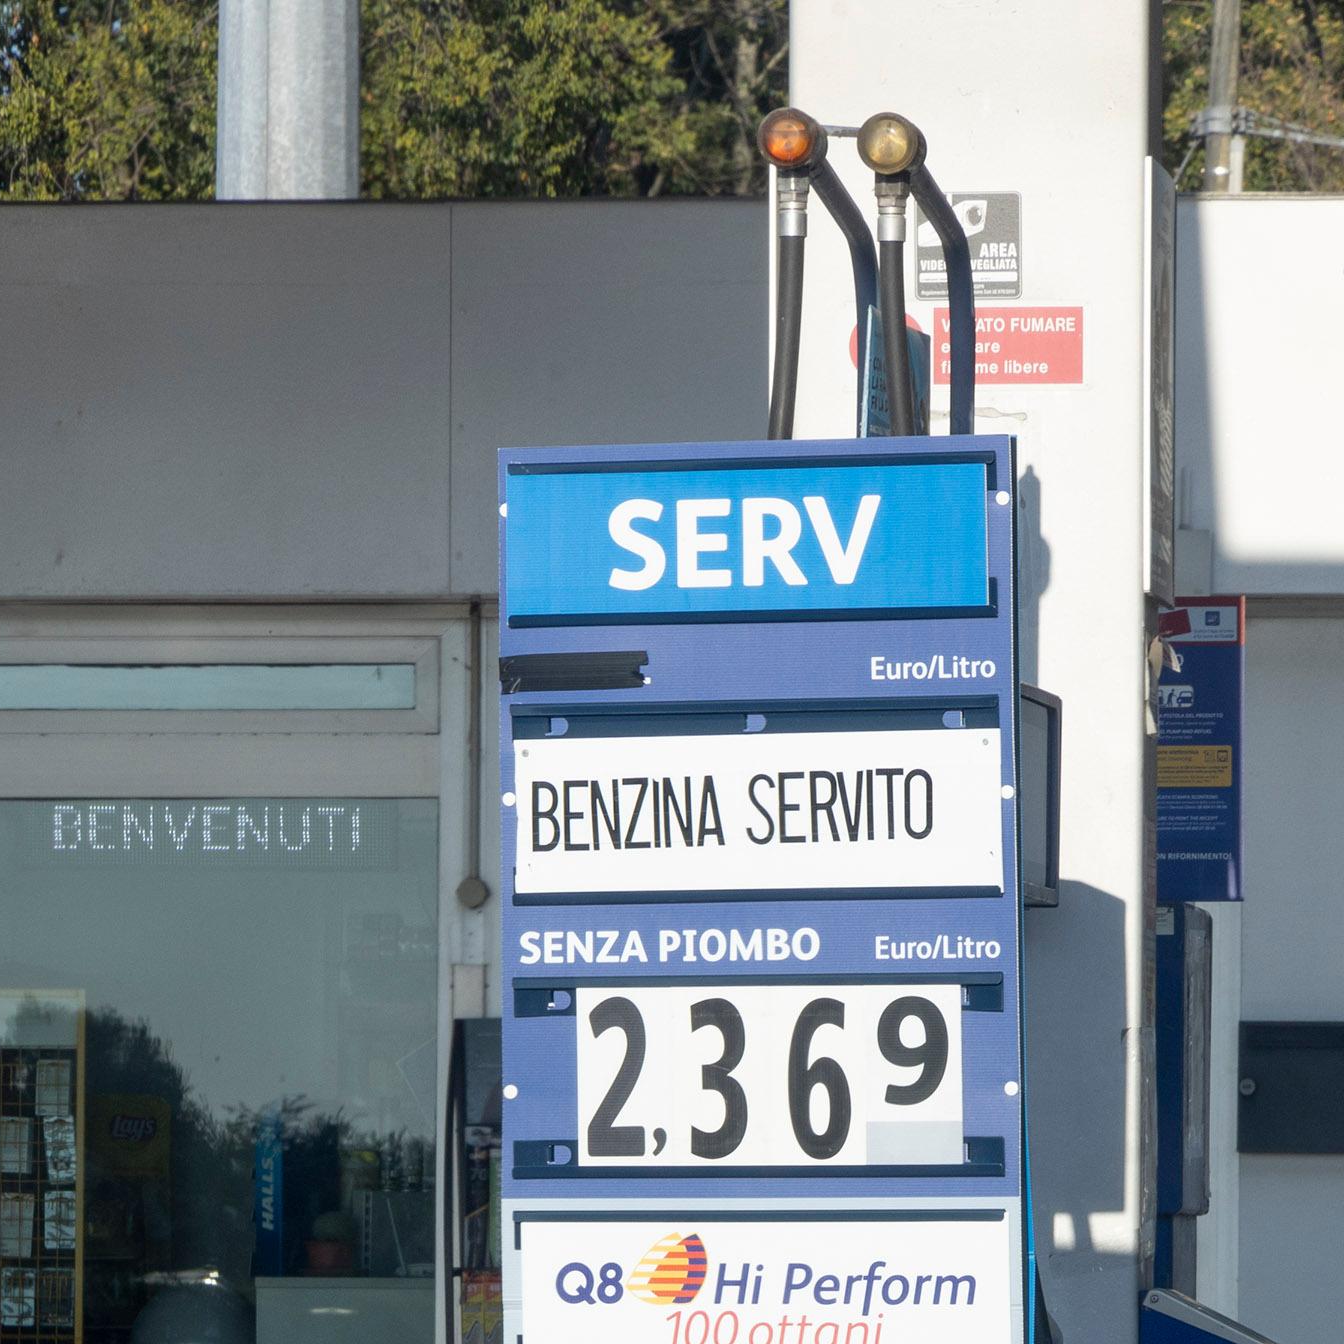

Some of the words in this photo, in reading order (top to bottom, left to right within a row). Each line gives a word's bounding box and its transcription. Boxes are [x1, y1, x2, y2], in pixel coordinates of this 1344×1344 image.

[919, 258, 1018, 272] VIDEVEGLIATA
[979, 242, 1018, 258] AREA
[941, 317, 1006, 333] VATO
[1010, 317, 1076, 332] FUMARE
[941, 360, 999, 374] fime
[1003, 360, 1049, 374] libere
[607, 494, 882, 592] SERV
[870, 654, 997, 682] Euro/Litro
[51, 804, 361, 852] BENVENUTI
[530, 774, 725, 853] BENZINA
[745, 767, 934, 846] SERVITO
[518, 930, 648, 966] SENZA
[659, 927, 821, 962] PIOMBO
[874, 935, 1002, 961] Euro/Litro
[586, 995, 950, 1160] 2,369
[261, 1156, 275, 1232] HALLS
[555, 1261, 625, 1306] Q8
[713, 1262, 762, 1305] Hi
[782, 1260, 977, 1316] Perform
